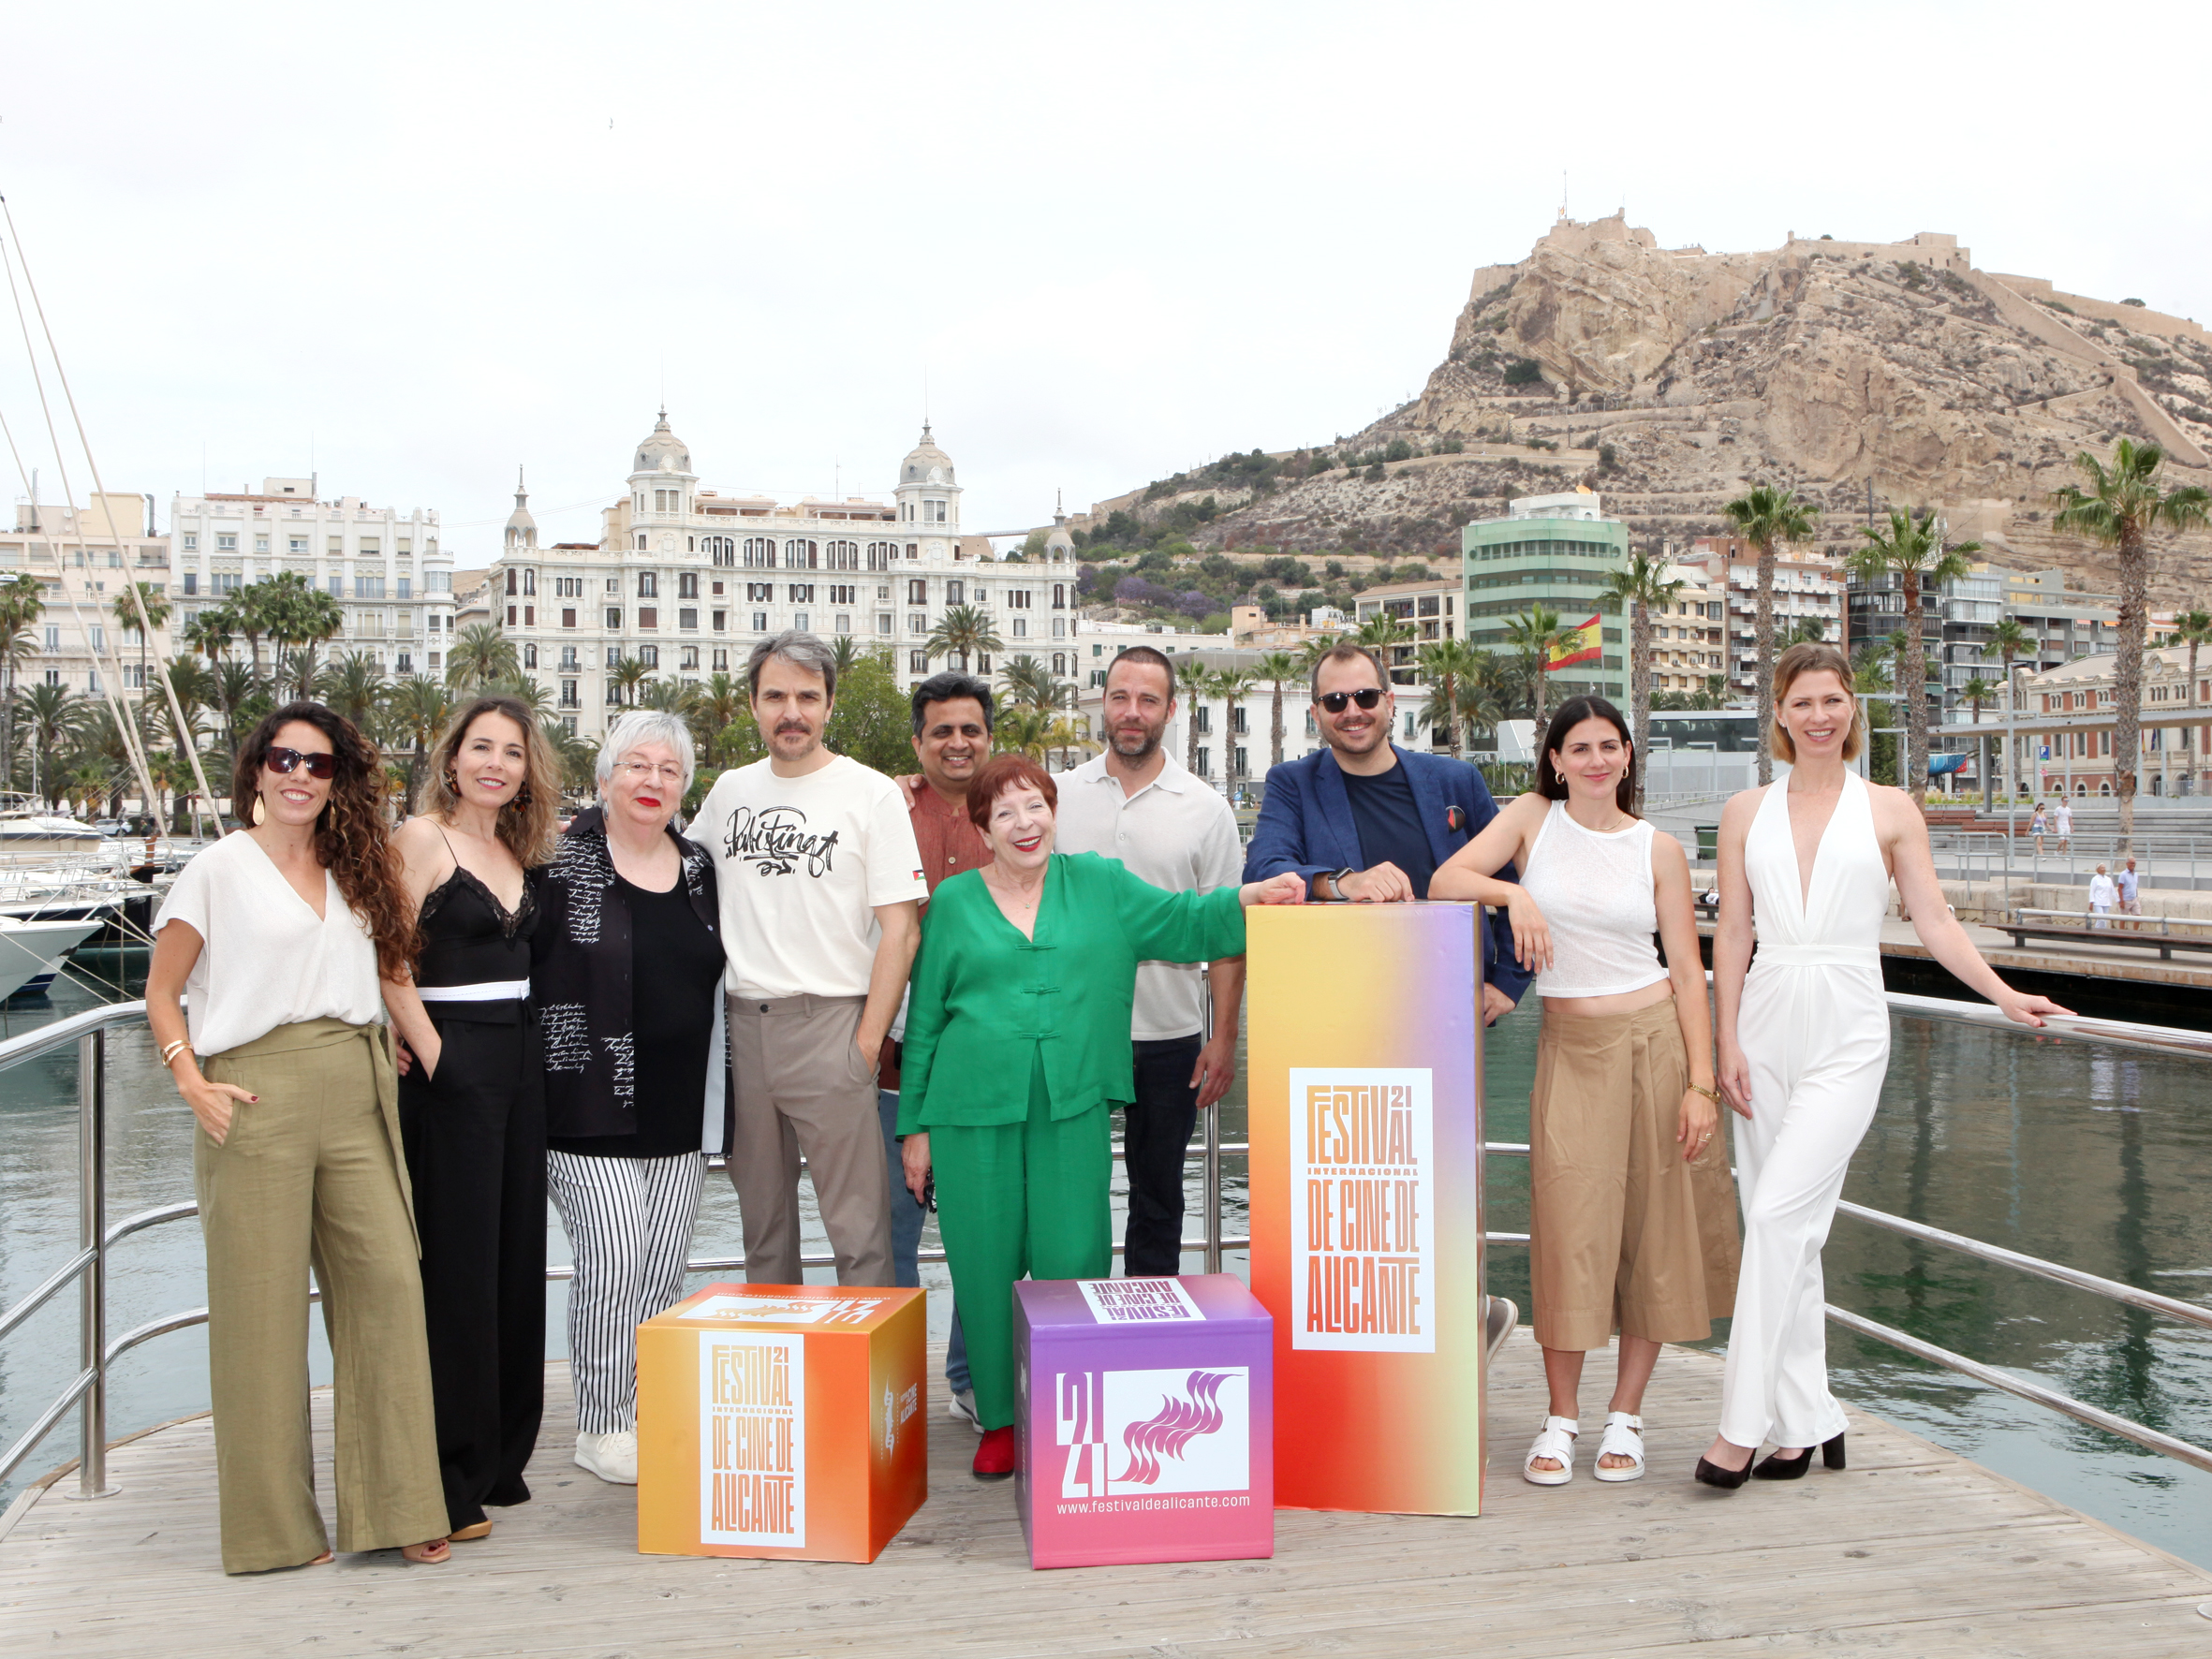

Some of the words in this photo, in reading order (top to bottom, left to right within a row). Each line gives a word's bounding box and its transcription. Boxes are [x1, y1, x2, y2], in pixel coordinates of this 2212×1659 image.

[2041, 746, 2046, 755] P
[1391, 1086, 1412, 1108] 21
[1306, 1085, 1418, 1165] FESTIVAL
[1307, 1167, 1419, 1176] INTERNACIONAL
[1307, 1180, 1334, 1252] DE
[1339, 1180, 1391, 1253] CINE
[1394, 1180, 1420, 1253] DE
[1088, 1281, 1172, 1294] ALICANTE
[1306, 1255, 1421, 1335] ALICANTE
[1097, 1294, 1116, 1306] DE
[1115, 1293, 1158, 1305] CINE
[1158, 1292, 1181, 1304] DE
[1102, 1305, 1191, 1320] FESTIVAL
[774, 1346, 789, 1363] 21
[711, 1344, 793, 1406] FESTIVAL
[712, 1406, 793, 1415] INTERNACIONAL
[713, 1416, 731, 1471] DE
[736, 1416, 773, 1472] CINE
[776, 1417, 794, 1472] DE
[711, 1474, 795, 1534] ALICANTE
[1056, 1495, 1250, 1515] www.festivaldealicante.com
